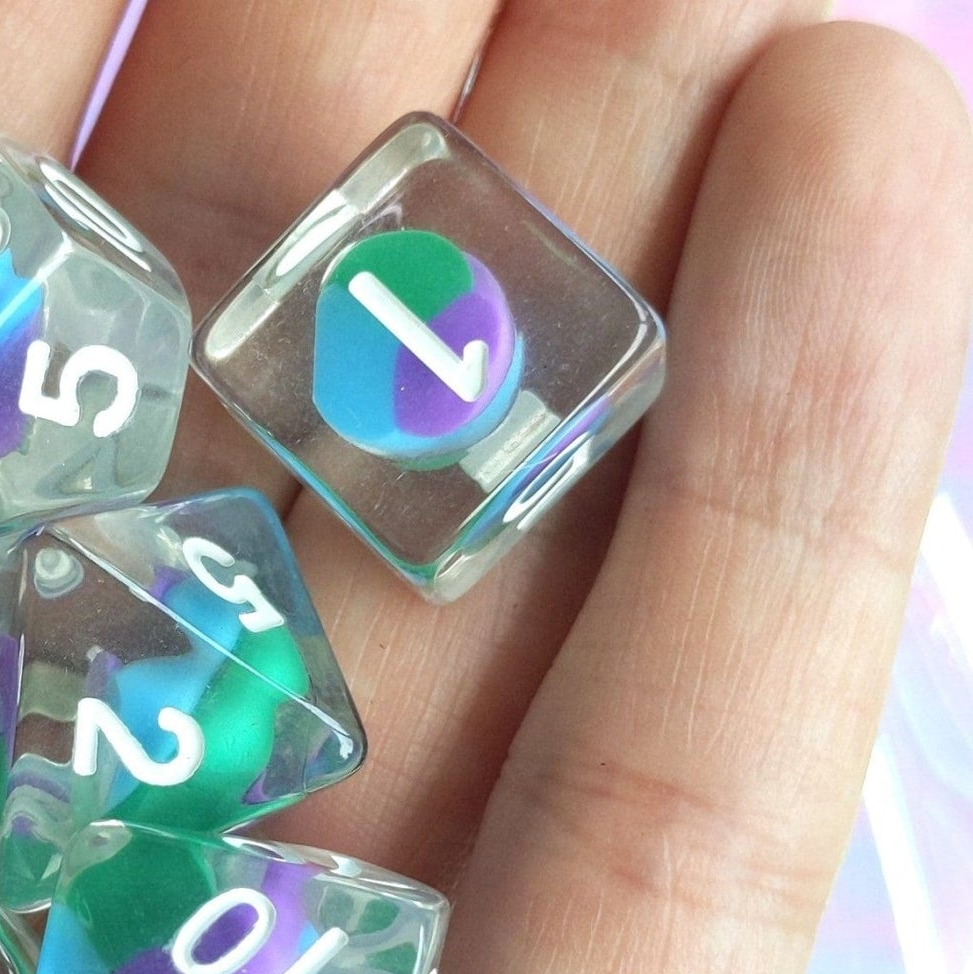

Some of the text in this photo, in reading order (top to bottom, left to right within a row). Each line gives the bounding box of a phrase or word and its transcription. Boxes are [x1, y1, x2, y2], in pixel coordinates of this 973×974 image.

[348, 271, 488, 403] 1
[19, 340, 139, 438] 5
[182, 536, 286, 634] 5
[73, 698, 205, 786] 2
